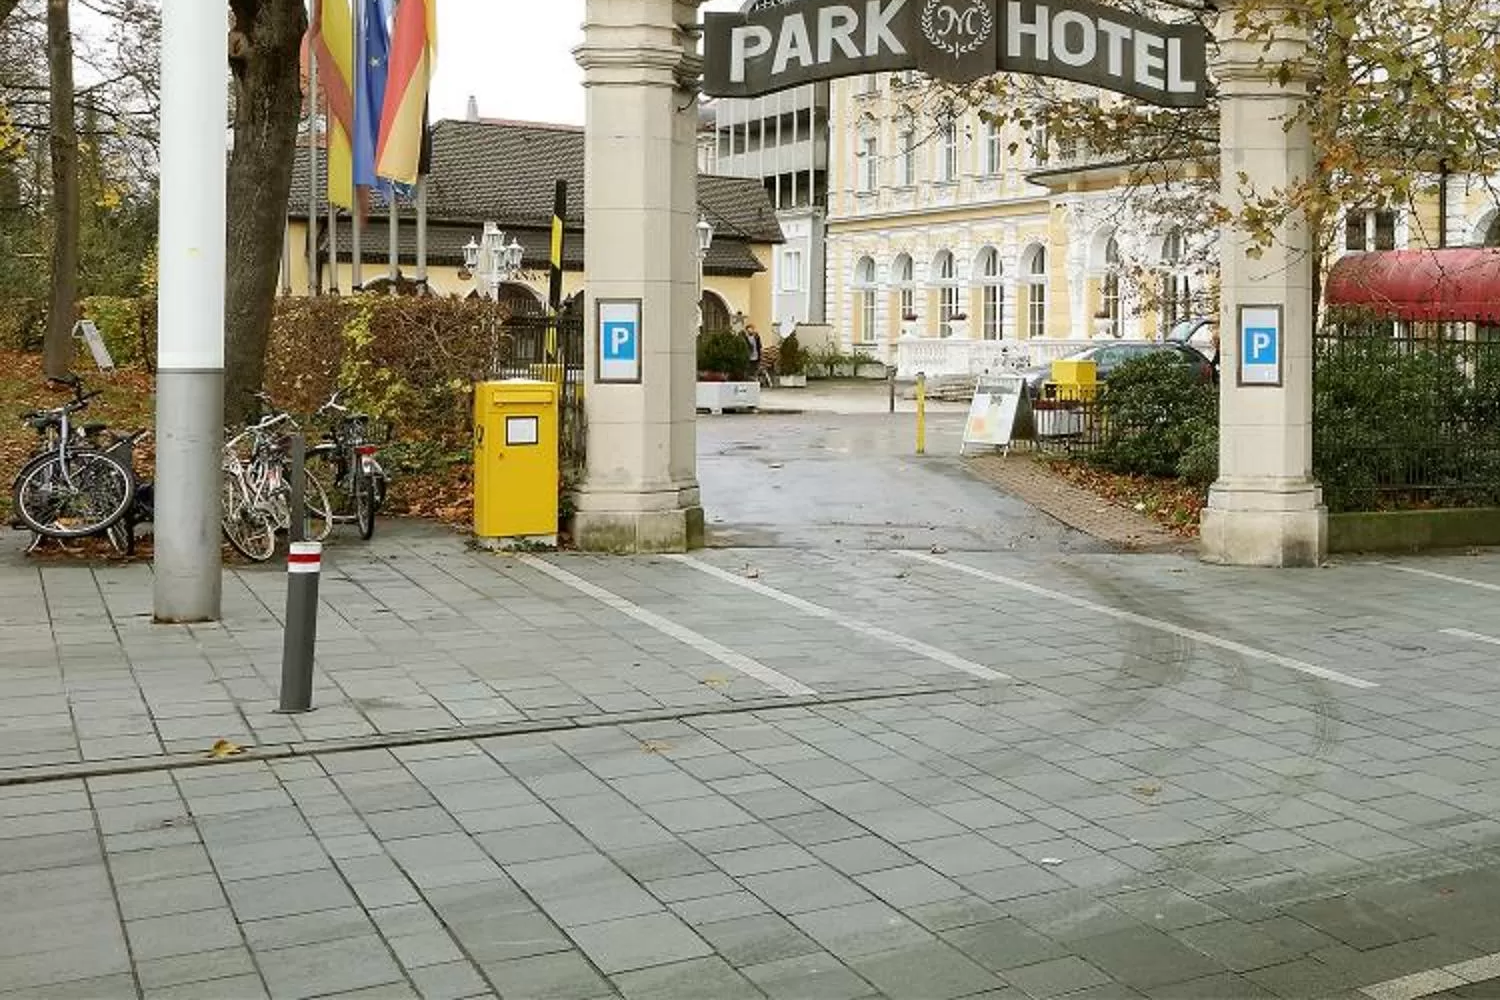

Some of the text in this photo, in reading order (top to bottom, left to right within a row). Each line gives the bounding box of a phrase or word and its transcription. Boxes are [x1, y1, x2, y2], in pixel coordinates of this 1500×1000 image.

[1008, 1, 1197, 93] HOTEL
[611, 327, 629, 355] P
[1253, 332, 1270, 359] P
